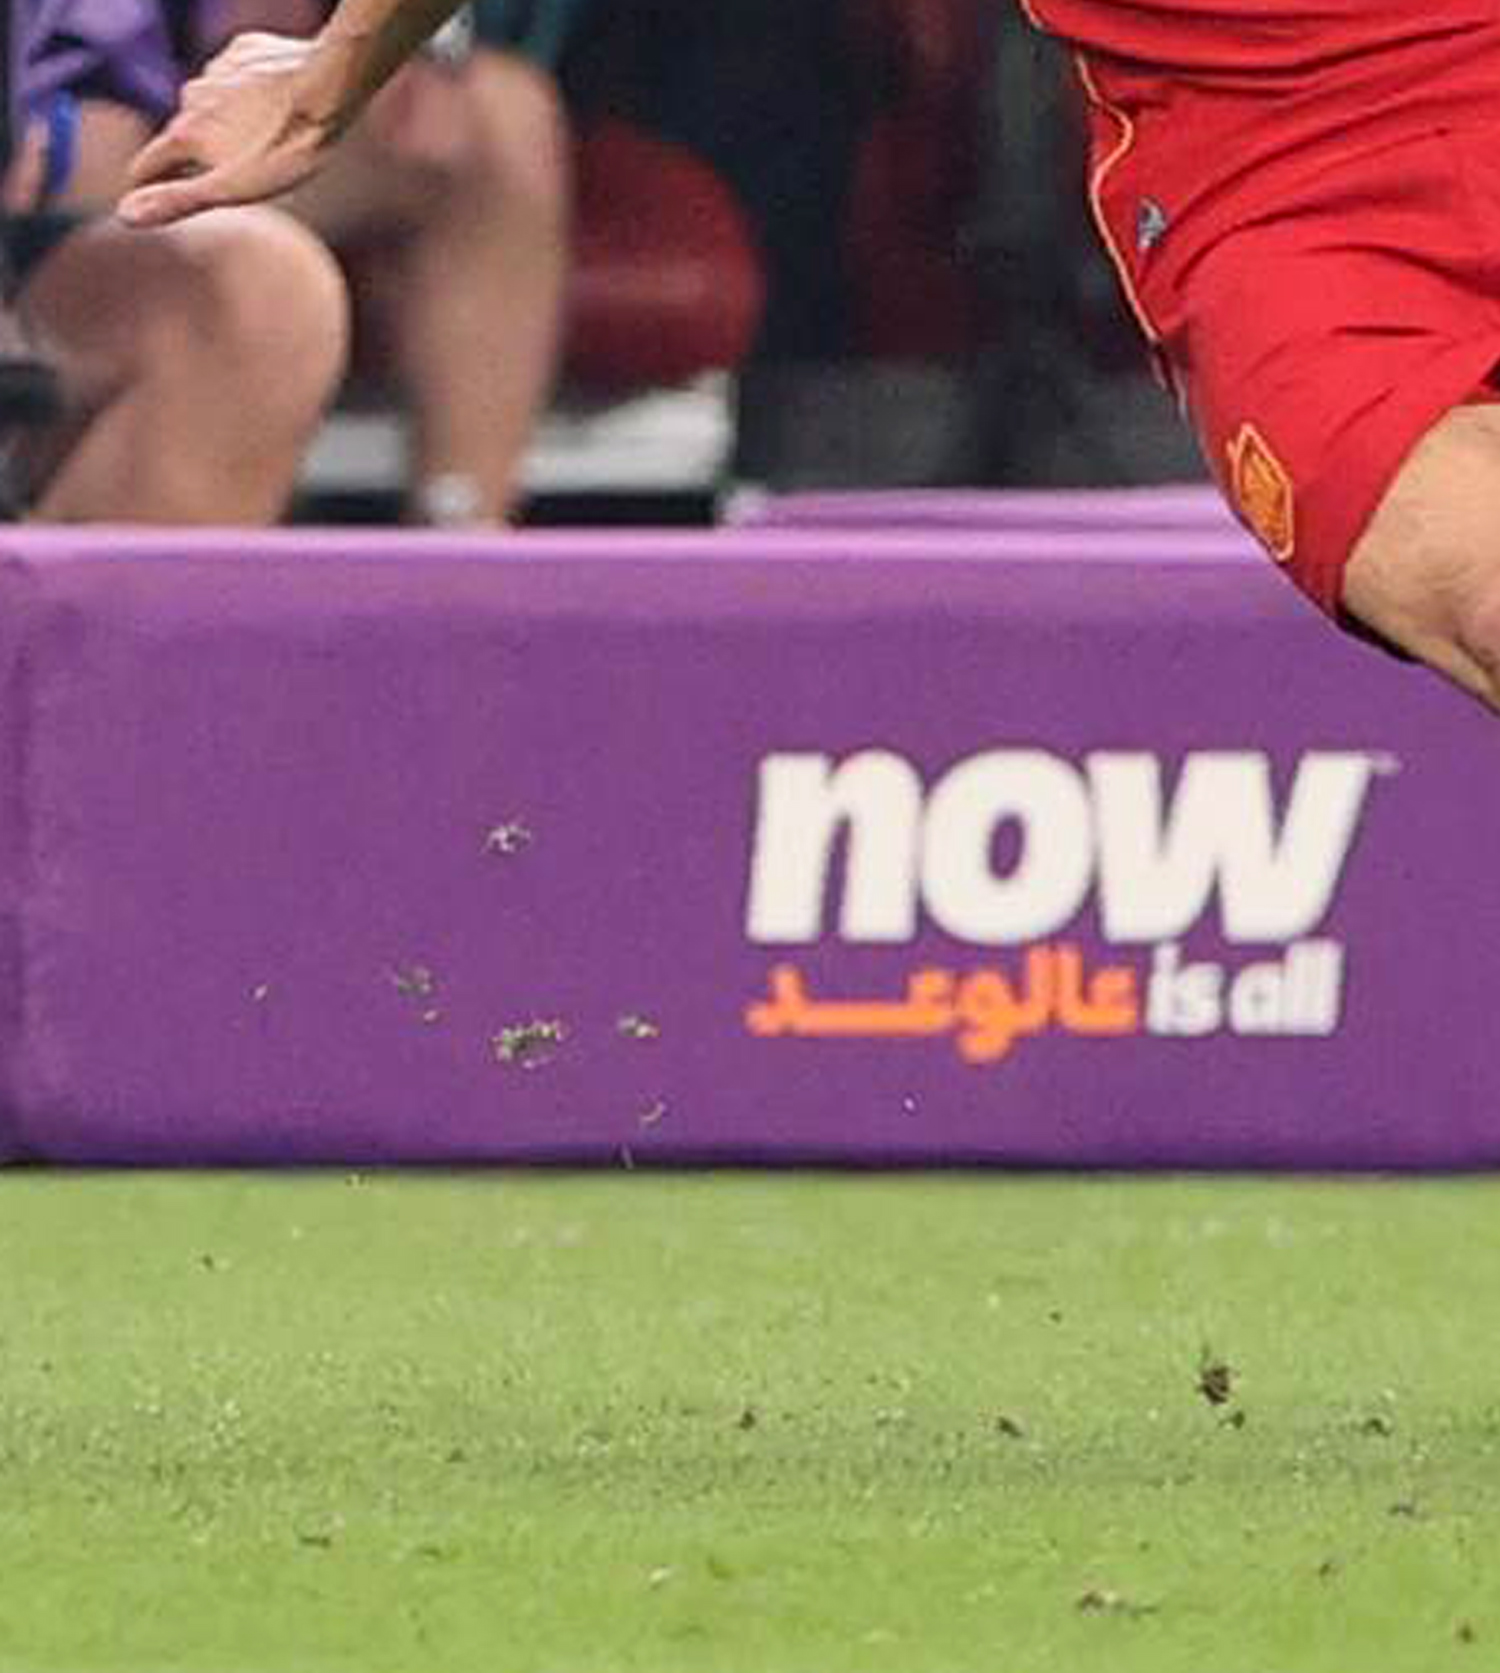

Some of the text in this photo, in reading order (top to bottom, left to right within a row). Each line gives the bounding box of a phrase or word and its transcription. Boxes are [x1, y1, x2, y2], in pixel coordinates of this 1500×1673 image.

[746, 748, 1376, 946] now
[1145, 939, 1343, 1036] is all
